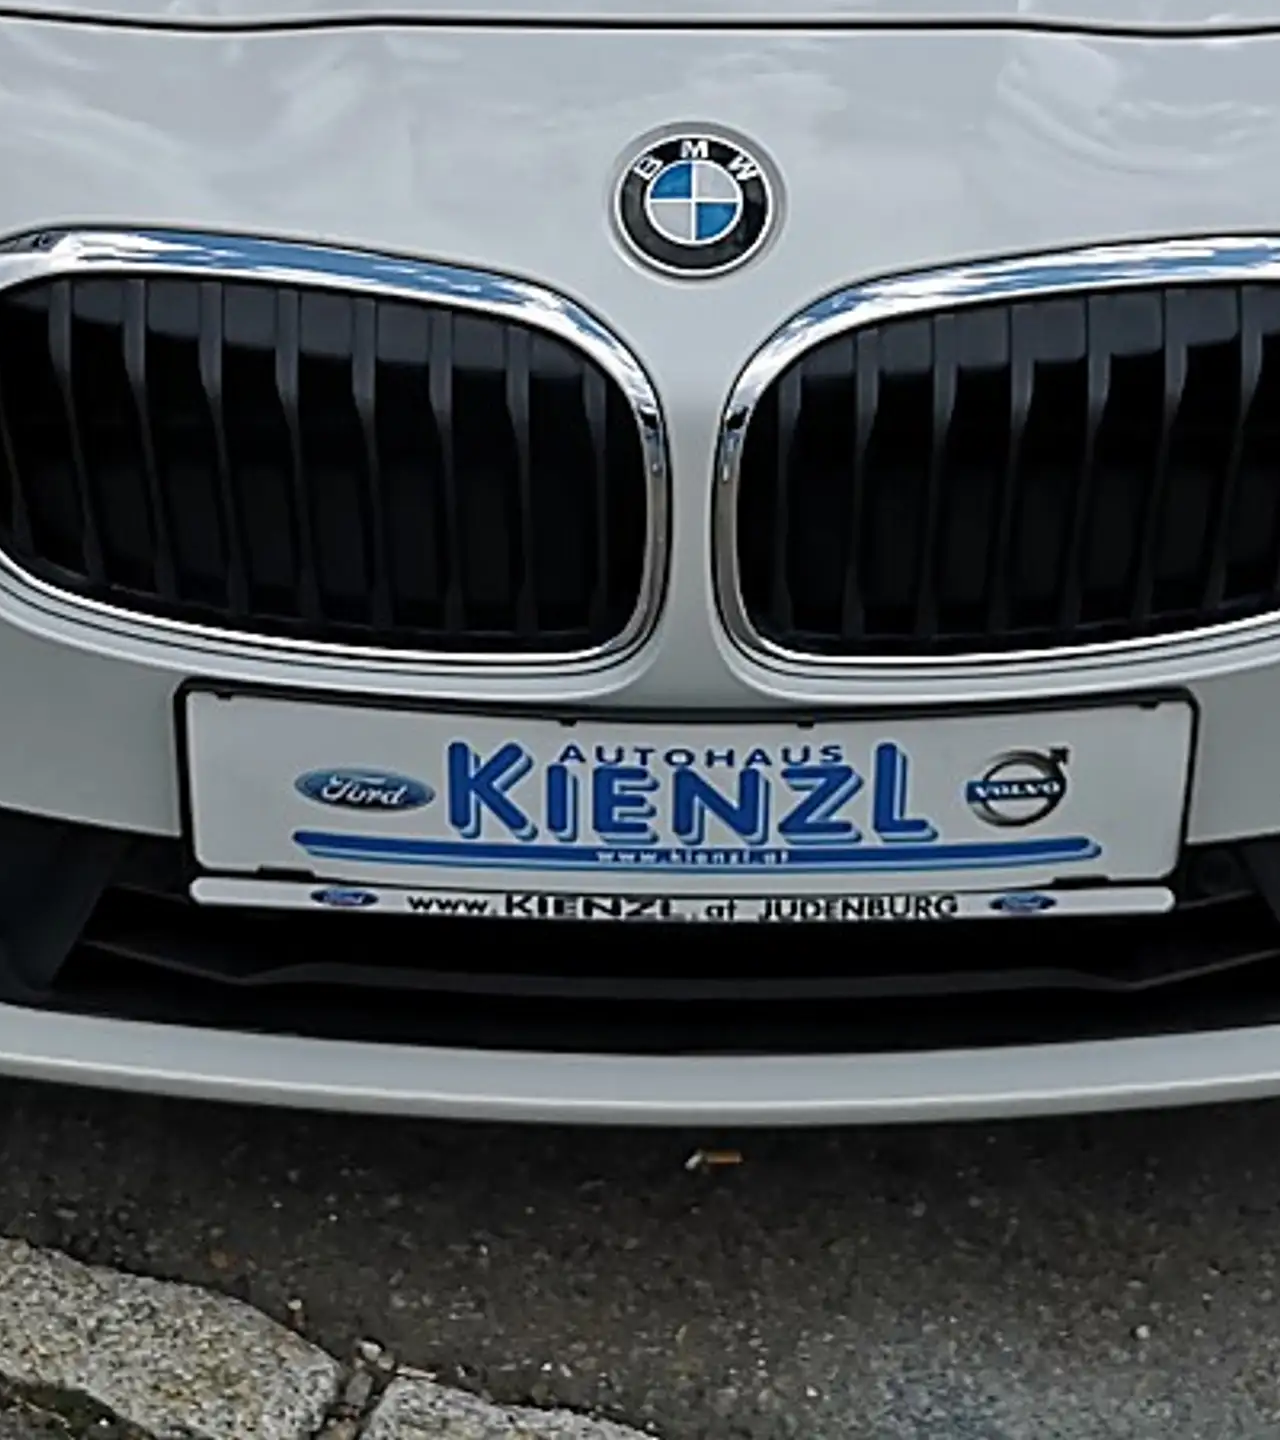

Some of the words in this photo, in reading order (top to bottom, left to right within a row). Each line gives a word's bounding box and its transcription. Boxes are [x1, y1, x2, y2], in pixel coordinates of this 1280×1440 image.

[633, 140, 759, 181] BMW
[556, 744, 844, 767] AUTOHAUS
[320, 773, 410, 807] Ford
[447, 741, 939, 845] KIENZL
[972, 779, 1062, 800] VOLVO
[760, 892, 960, 920] JUDENBURG
